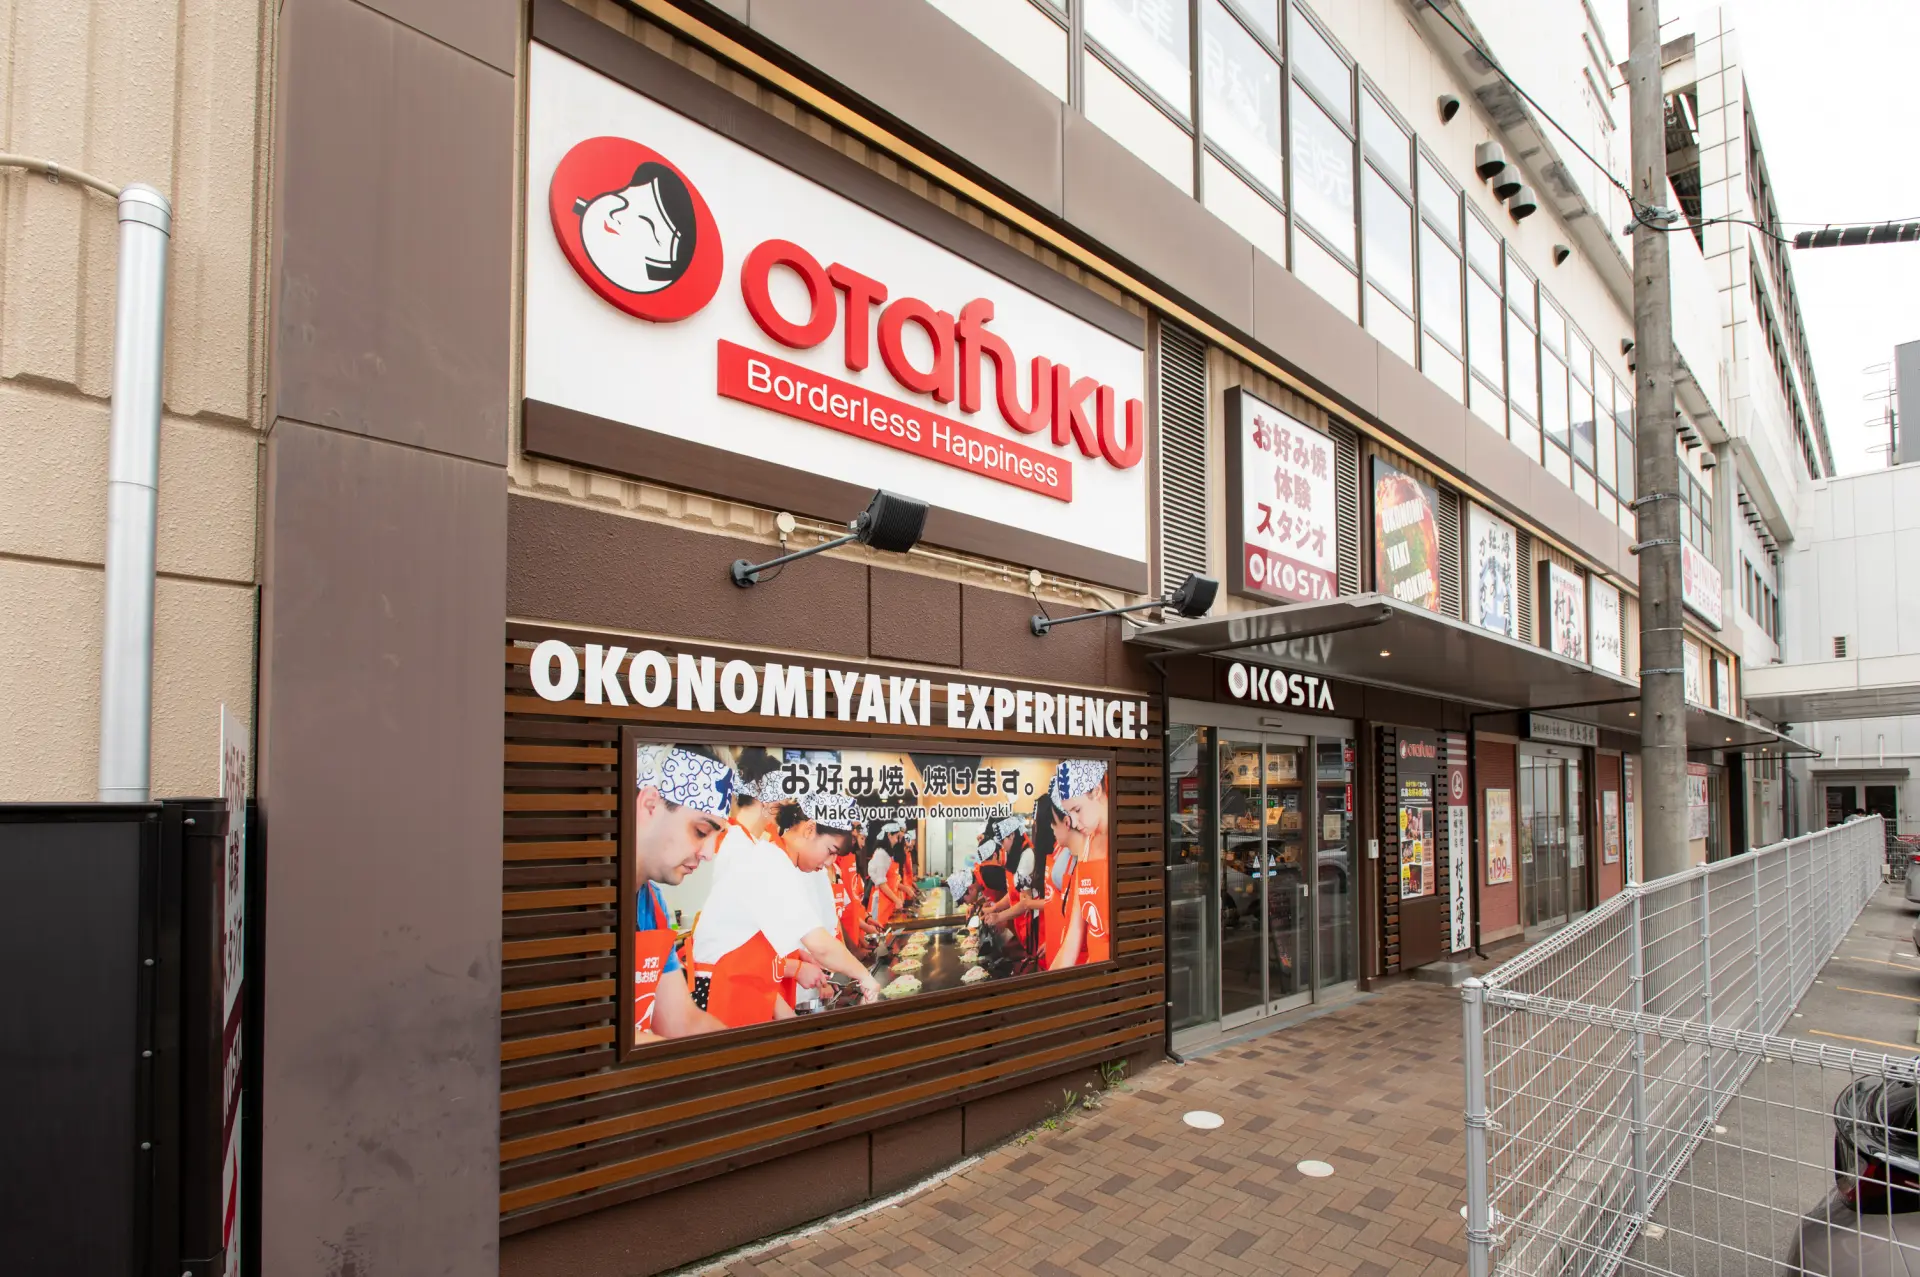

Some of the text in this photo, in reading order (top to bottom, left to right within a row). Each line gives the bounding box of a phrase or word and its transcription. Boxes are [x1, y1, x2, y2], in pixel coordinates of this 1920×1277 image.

[747, 359, 1058, 487] Borderless Happiness
[1253, 414, 1327, 481] お好み焼
[1274, 465, 1311, 512] 体験
[1256, 503, 1327, 557] スタジオ
[1382, 498, 1424, 534] OKONOMI
[1249, 553, 1332, 600] OKOSTA
[1387, 540, 1410, 571] YAKI
[1394, 568, 1432, 603] COOKING
[529, 639, 1149, 740] OKONOMIYAKI EXPERIENCE!
[1228, 662, 1335, 710] OKOSTA
[781, 763, 1034, 796] お好み焼、焼けます。
[815, 803, 1013, 822] Make your own okonomiyaki!
